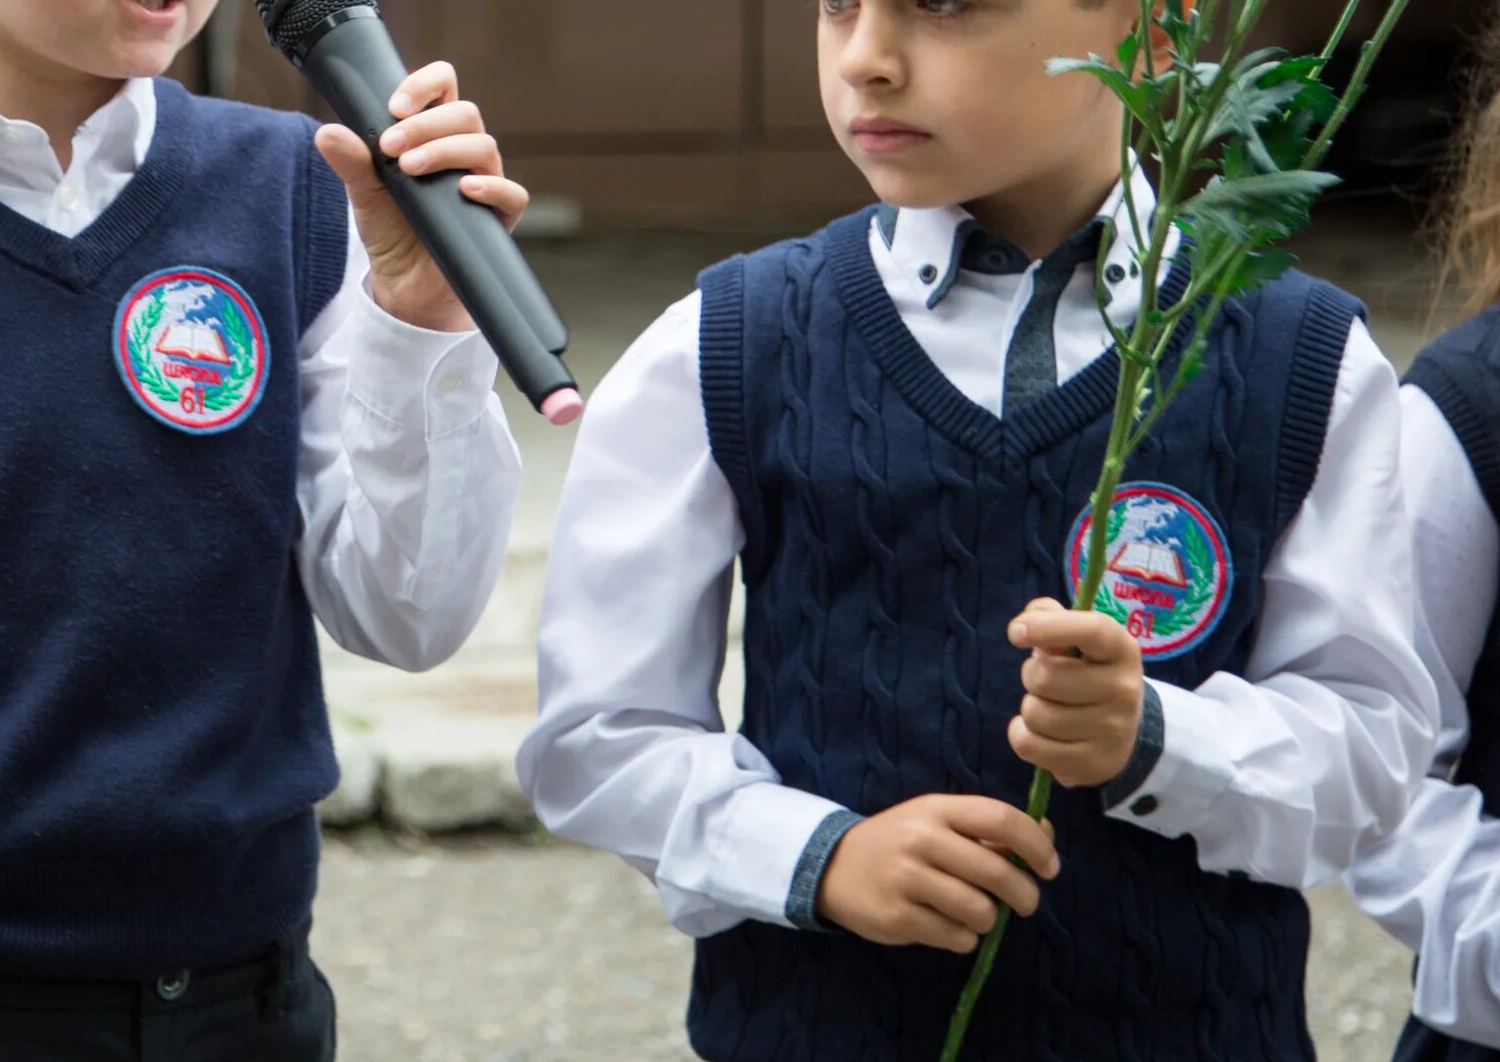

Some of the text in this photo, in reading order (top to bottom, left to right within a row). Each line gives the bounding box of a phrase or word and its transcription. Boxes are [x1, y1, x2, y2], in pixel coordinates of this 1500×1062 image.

[180, 387, 205, 415] 61
[1113, 581, 1175, 610] ШКОЛА
[1127, 609, 1155, 639] 61
